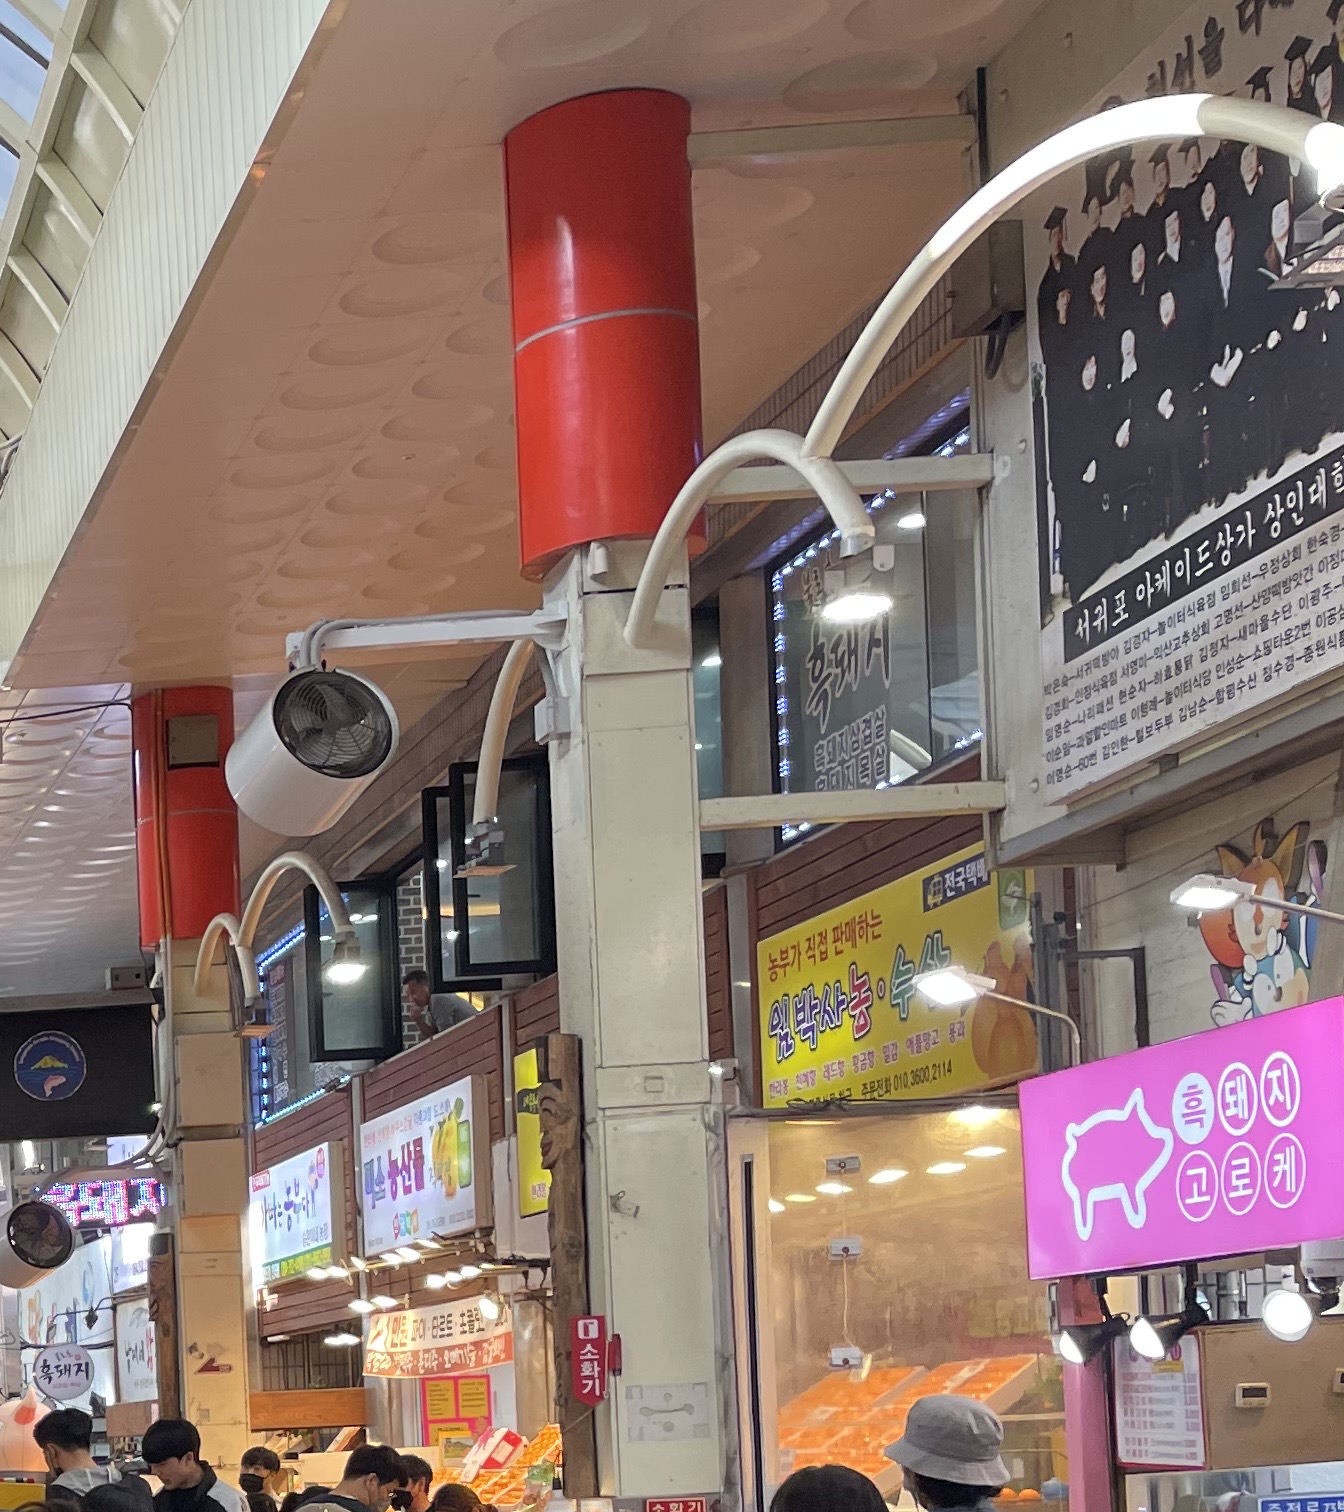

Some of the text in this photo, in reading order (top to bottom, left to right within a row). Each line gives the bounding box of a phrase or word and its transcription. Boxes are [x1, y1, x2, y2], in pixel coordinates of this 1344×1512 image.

[1075, 589, 1130, 648] 서귀포
[1135, 510, 1257, 610] 아케이드상가
[768, 908, 883, 983] 농부가 직접 판매하는
[39, 1358, 91, 1386] 흑돼지
[579, 1343, 601, 1398] 소화기
